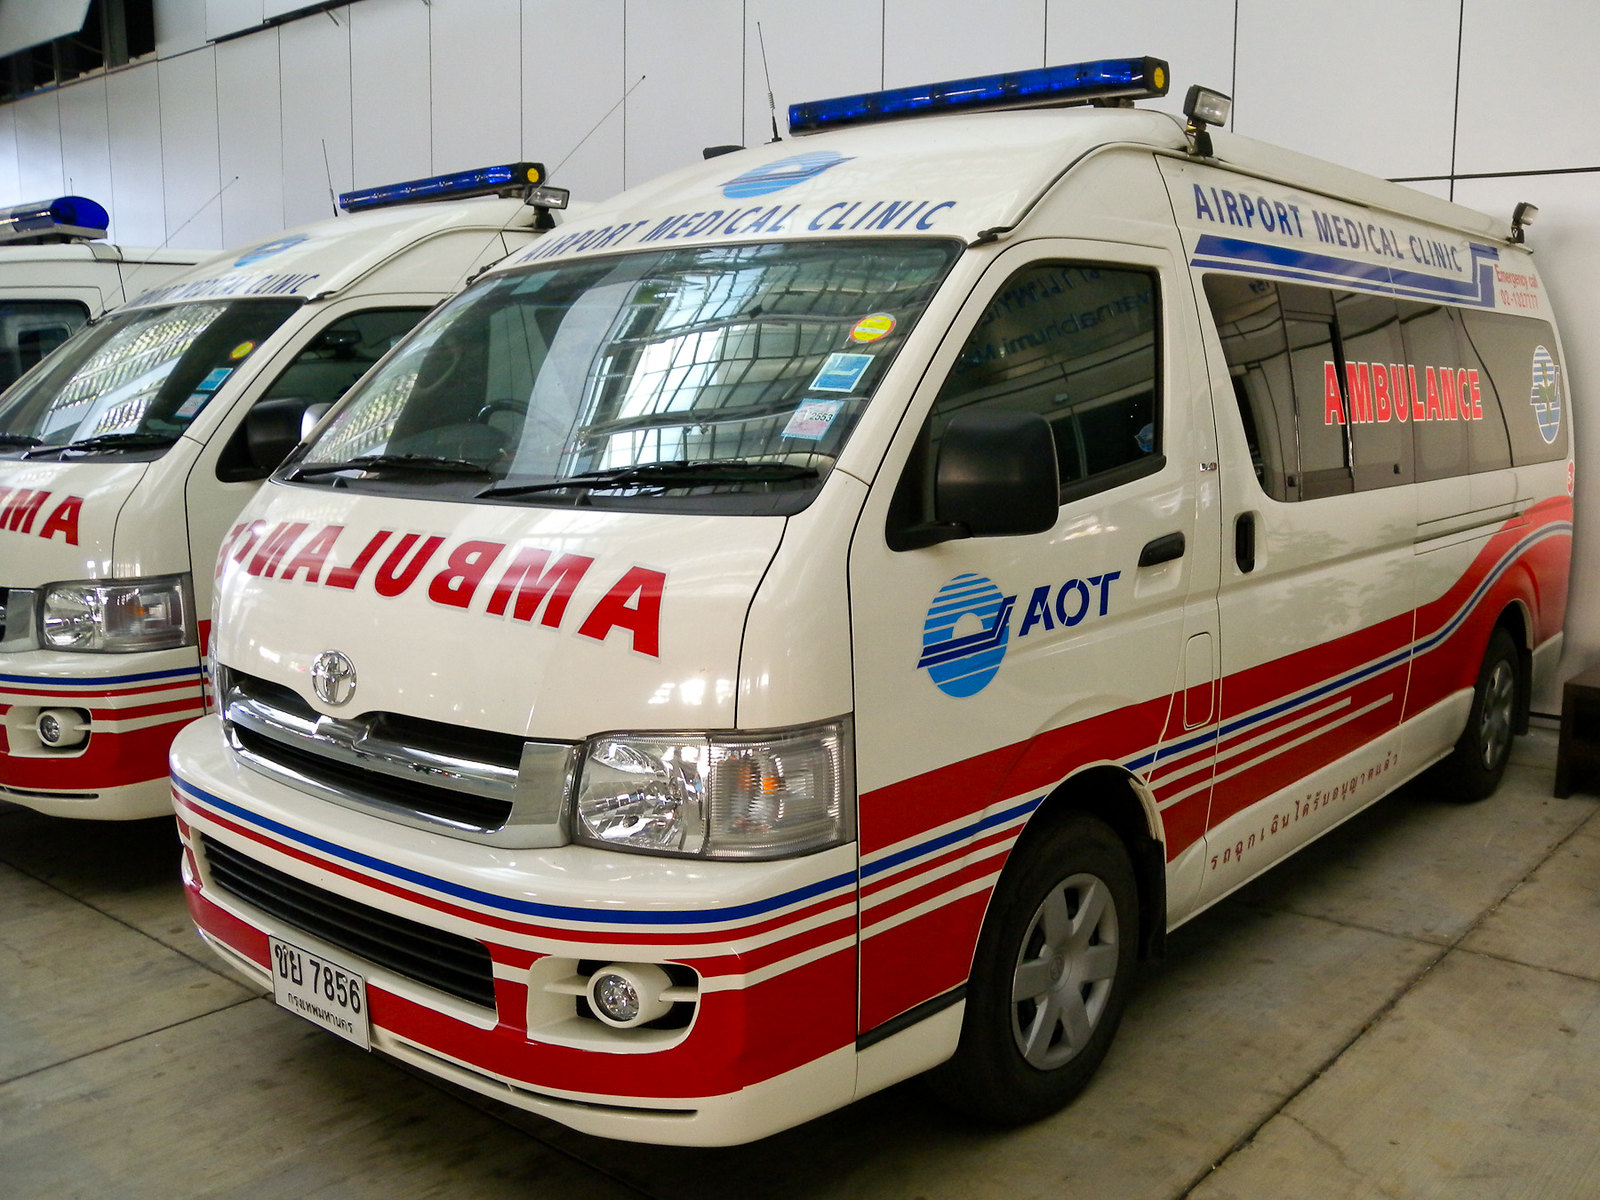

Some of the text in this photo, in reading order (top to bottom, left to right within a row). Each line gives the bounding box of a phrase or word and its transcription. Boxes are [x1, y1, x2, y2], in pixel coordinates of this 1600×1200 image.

[516, 201, 956, 263] AIRPORT MEDICAL CLINIC
[1193, 184, 1463, 273] AIRPORT MEDICAL CLINIC
[244, 273, 320, 294] CLINIC
[1494, 264, 1528, 289] Emergency
[809, 412, 833, 422] 2553
[1324, 360, 1483, 426] AMBULANCE
[1018, 570, 1122, 637] AOT
[309, 958, 361, 1015] 7856
